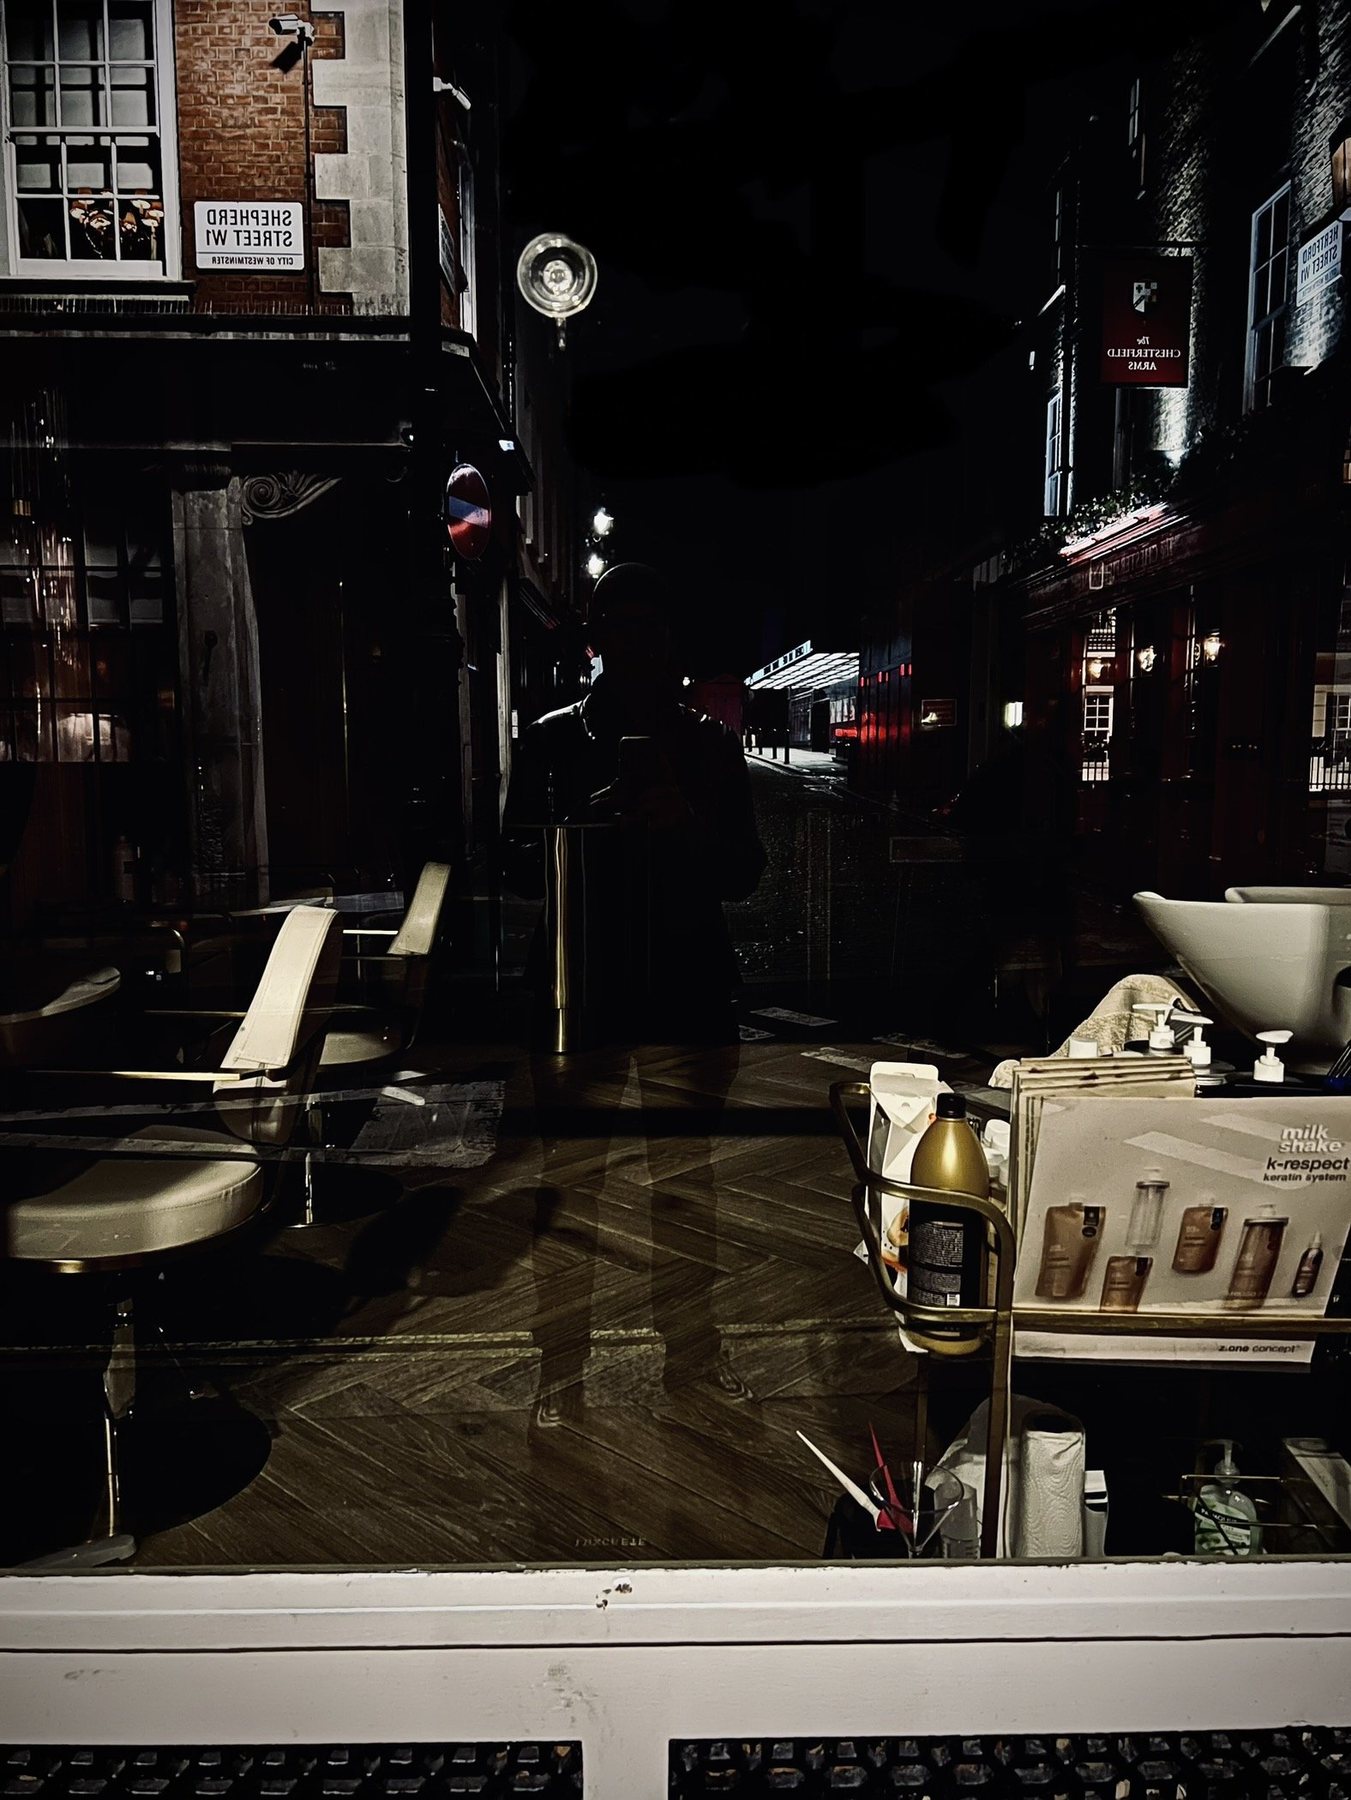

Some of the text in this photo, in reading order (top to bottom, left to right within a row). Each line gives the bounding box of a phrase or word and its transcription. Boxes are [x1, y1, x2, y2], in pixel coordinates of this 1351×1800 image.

[1278, 1138, 1343, 1154] shake
[1266, 1156, 1350, 1173] k-respect
[1263, 1172, 1347, 1183] keratin system
[1218, 1345, 1250, 1353] z.one
